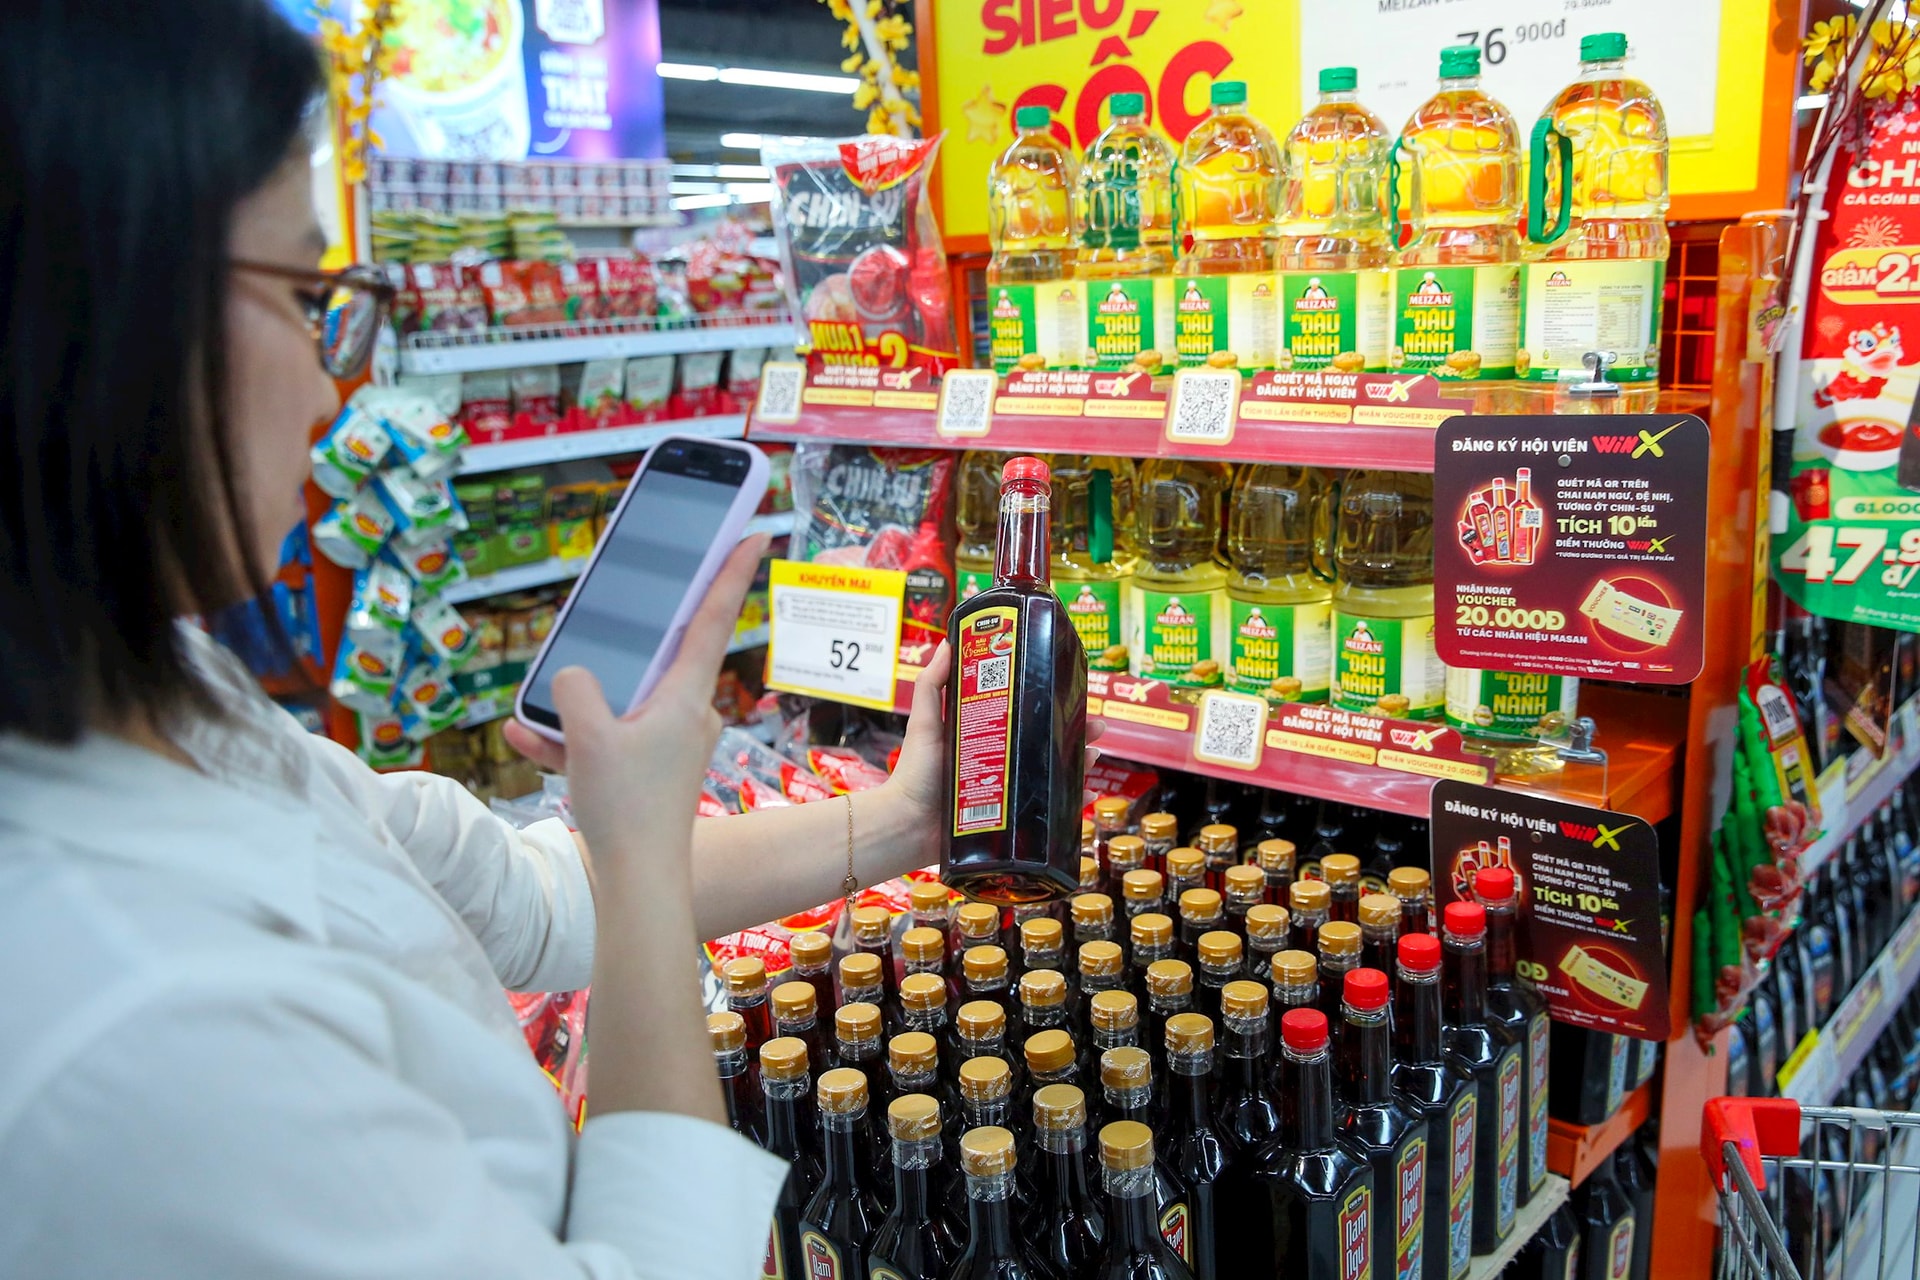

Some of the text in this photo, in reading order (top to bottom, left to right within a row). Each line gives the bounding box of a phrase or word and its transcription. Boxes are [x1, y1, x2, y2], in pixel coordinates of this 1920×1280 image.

[1843, 192, 1908, 206] CÁ CƠM
[1295, 299, 1338, 311] MEIZAN
[1408, 294, 1453, 306] MEIZAN
[1099, 302, 1138, 313] MEIZAN
[1273, 372, 1358, 385] QUÉT MÃ NGAY
[1256, 384, 1288, 396] ĐĂNG
[1289, 384, 1305, 397] KÝ
[1307, 386, 1328, 400] HỘI
[1330, 386, 1357, 399] VIÊN
[1452, 438, 1494, 453] ĐĂNG
[1497, 437, 1517, 452] KÝ
[1521, 440, 1548, 456] HỘI
[1551, 438, 1588, 453] VIÊN
[1557, 478, 1649, 489] QUÉT MÃ QR TRÊN
[1557, 491, 1674, 503] CHAI NAM NGƯ, ĐỆ NHỊ,
[1557, 501, 1655, 513] TƯƠNG ỚT CHIN-SU
[1556, 515, 1657, 536] TÍCH 10 lần
[1555, 536, 1581, 548] ĐIỂM
[1582, 539, 1625, 549] THƯỞNG
[1616, 553, 1629, 561] GIÁ
[800, 573, 846, 588] KHUYẾN
[1456, 584, 1513, 595] NHẬN NGAY
[1068, 603, 1106, 612] MEIZAN
[1456, 594, 1516, 607] VOUCHER
[976, 617, 1000, 628] CHIN-SU
[1157, 614, 1195, 625] MEIZAN
[1455, 606, 1566, 631] 20.000Đ
[1239, 625, 1277, 638] MEIZAN
[1457, 627, 1588, 645] TỪ CÁC NHÃN HIỆU MASAN
[1345, 639, 1383, 653] MEIZAN
[1300, 706, 1384, 730] QUÉT MÃ NGAY
[1282, 716, 1314, 731] ĐĂNG
[1315, 720, 1331, 734] KÝ
[1333, 725, 1354, 740] HỘI
[1355, 729, 1383, 743] VIÊN
[1406, 757, 1444, 771] VOUCHER
[1444, 800, 1479, 818] ĐĂNG
[1480, 808, 1498, 822] KÝ
[1500, 812, 1524, 828] HỘI
[1526, 818, 1557, 834] VIÊN
[1532, 852, 1610, 876] QUÉT MÃ QR TRÊN
[1532, 862, 1554, 874] CHAI
[1554, 867, 1574, 880] NAM
[1533, 872, 1617, 898] TƯƠNG ỚT CHIN-SU
[1533, 886, 1620, 914] TÍCH 10 lần
[1455, 1115, 1473, 1152] Nam
[1402, 1160, 1422, 1198] Nam
[1401, 1187, 1419, 1238] Ngư
[1345, 1209, 1367, 1250] Nam
[812, 1254, 831, 1278] Nam
